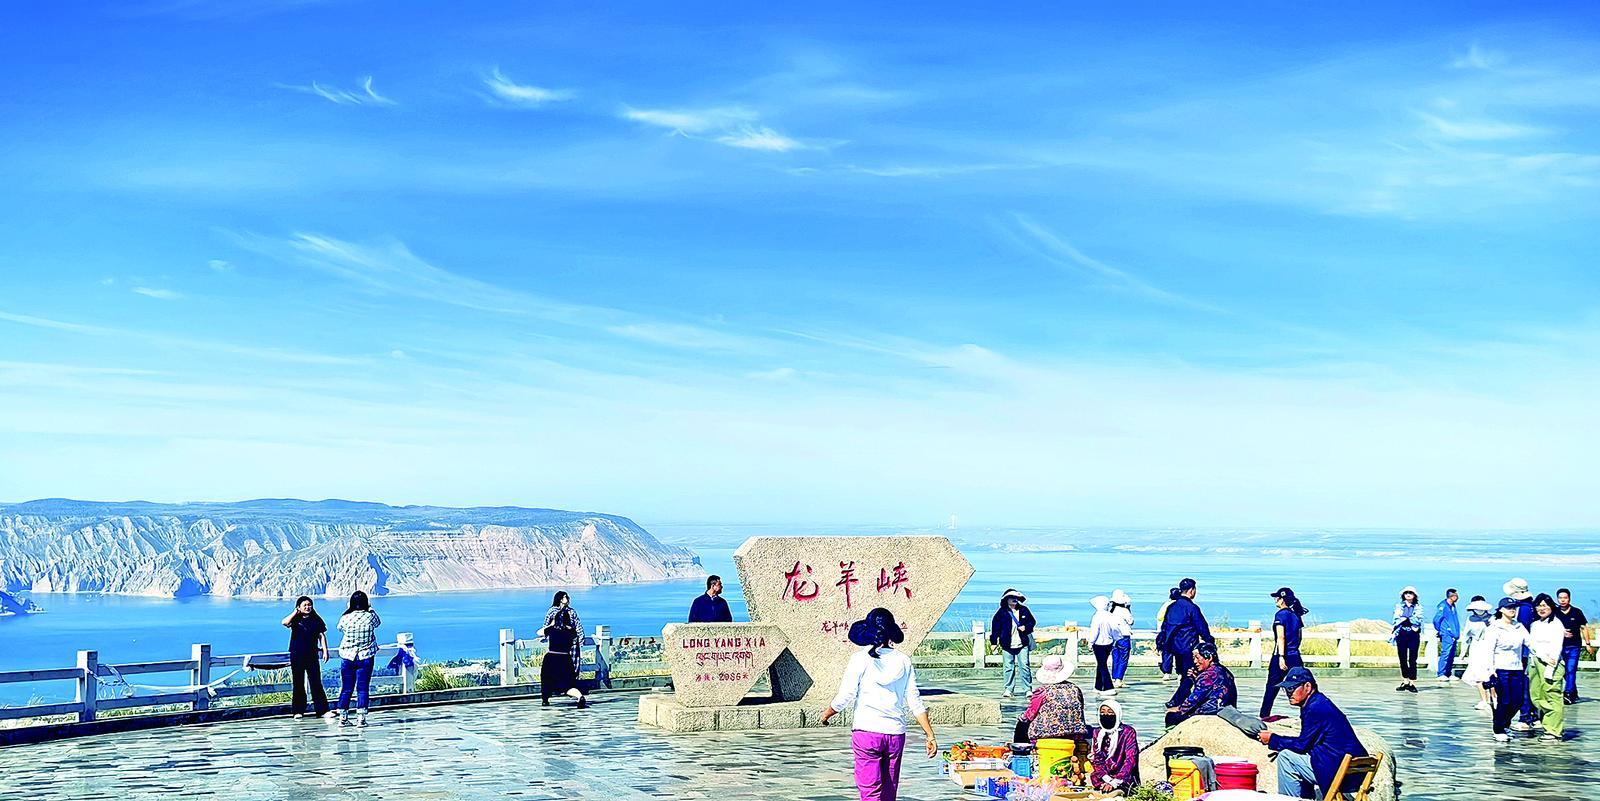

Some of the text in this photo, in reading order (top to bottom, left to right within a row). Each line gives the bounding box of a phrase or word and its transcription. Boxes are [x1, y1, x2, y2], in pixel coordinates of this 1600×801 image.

[782, 561, 912, 609] 龙羊峡
[683, 637, 766, 648] LONG YANG XIA
